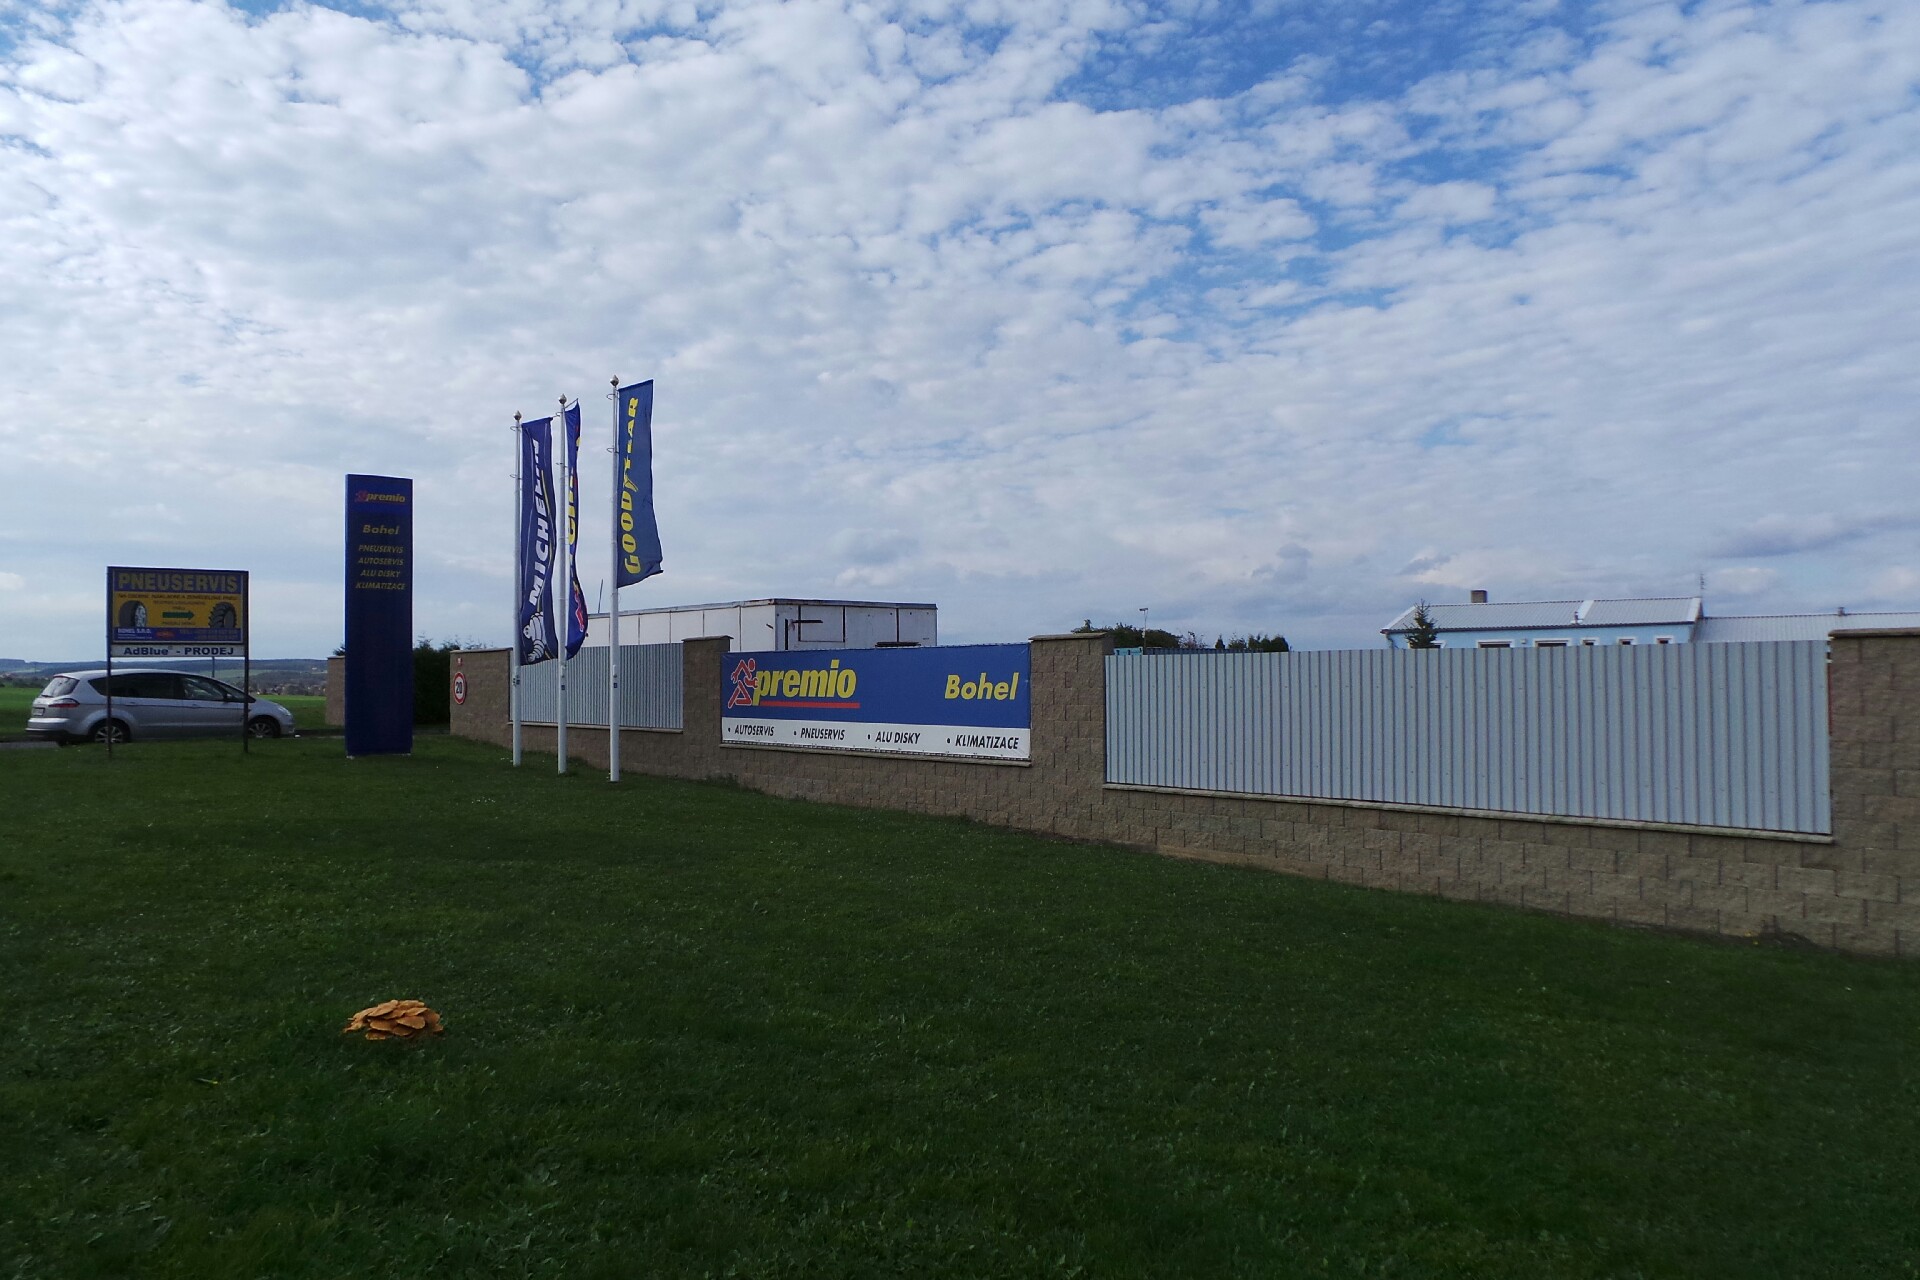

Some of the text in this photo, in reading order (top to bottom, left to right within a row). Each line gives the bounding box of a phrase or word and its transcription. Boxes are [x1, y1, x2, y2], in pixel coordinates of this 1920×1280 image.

[366, 492, 406, 503] premio
[362, 524, 400, 535] Bohel
[358, 545, 404, 554] PNEUSERVIS
[358, 557, 404, 566] AUTOSERVIS
[360, 569, 401, 578] ALU DISKY
[119, 572, 238, 592] PNEUSERVIS
[355, 582, 406, 590] KLIMATIZACE
[184, 647, 234, 656] PRODEJ
[752, 659, 1020, 706] premio Bohel
[734, 725, 775, 737] AUTOSERVIS
[800, 728, 845, 741] PNEUSERVIS
[875, 731, 921, 745] ALU DISKY
[955, 734, 1019, 750] KLIMATIZACE
